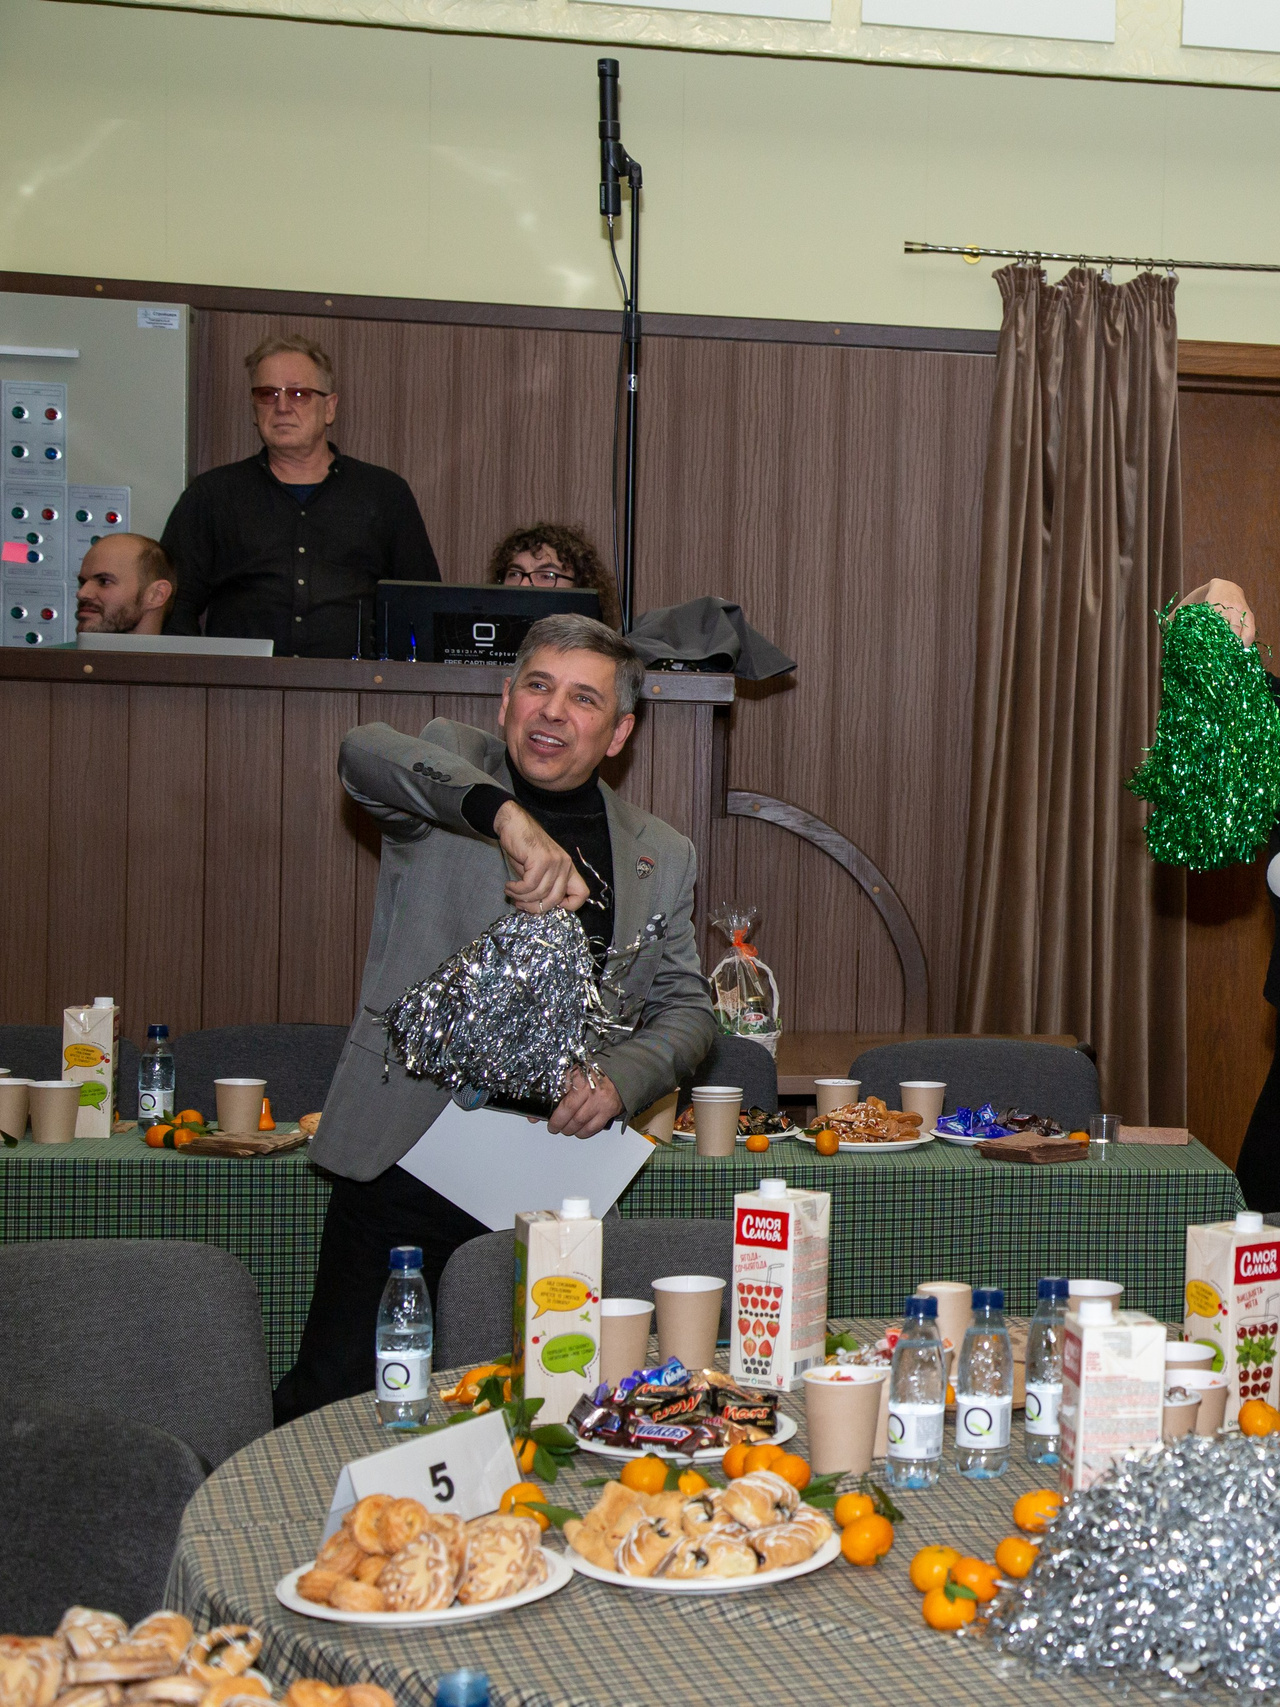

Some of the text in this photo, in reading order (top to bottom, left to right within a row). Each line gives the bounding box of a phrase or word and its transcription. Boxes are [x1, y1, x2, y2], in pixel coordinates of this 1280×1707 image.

[741, 1214, 783, 1243] Семья
[755, 1216, 782, 1231] МОЯ
[1239, 1250, 1278, 1278] Семья
[1252, 1248, 1278, 1265] МОЯ
[722, 1404, 771, 1421] Mars
[635, 1425, 690, 1439] NICKERS
[429, 1461, 455, 1503] 5
